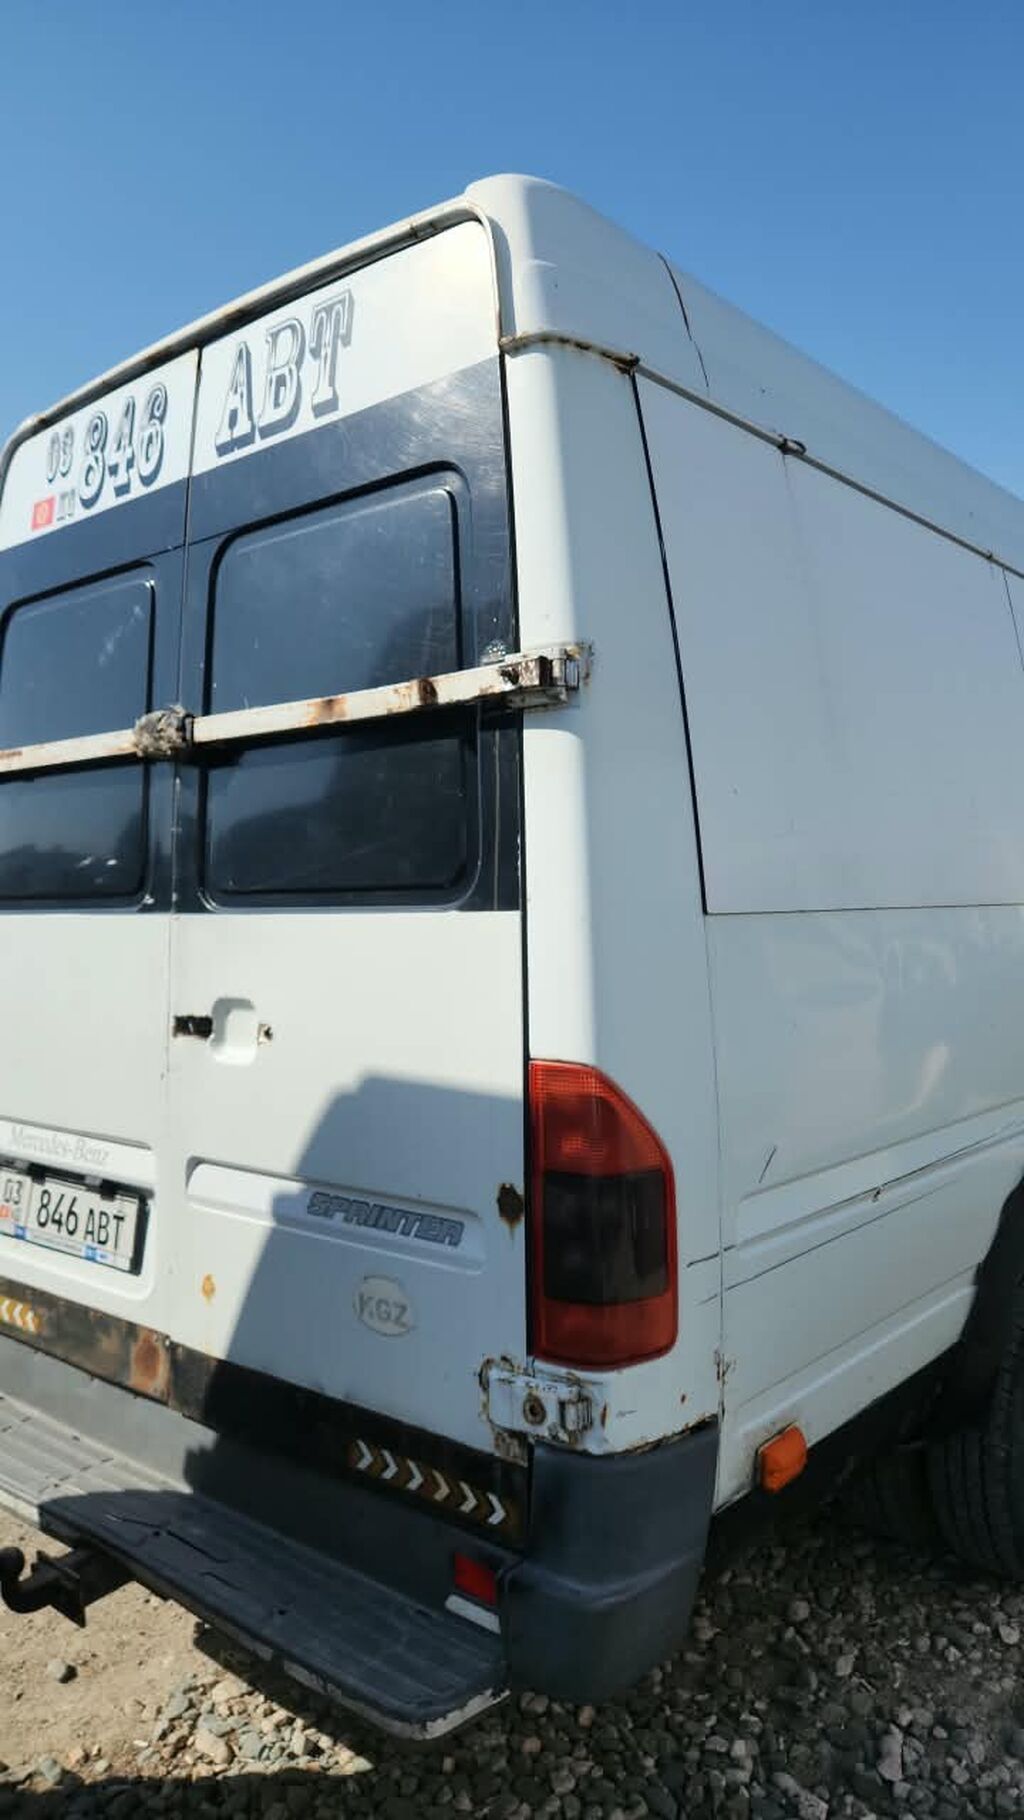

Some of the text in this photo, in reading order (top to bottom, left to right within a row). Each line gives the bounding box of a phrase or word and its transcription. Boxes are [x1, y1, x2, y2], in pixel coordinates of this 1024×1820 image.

[79, 382, 168, 510] 846
[215, 288, 356, 458] ABT
[3, 1178, 23, 1206] 03
[36, 1189, 79, 1237] 846
[83, 1208, 125, 1251] ABT
[306, 1191, 466, 1248] SPRINTER
[357, 1292, 411, 1328] KGZ
